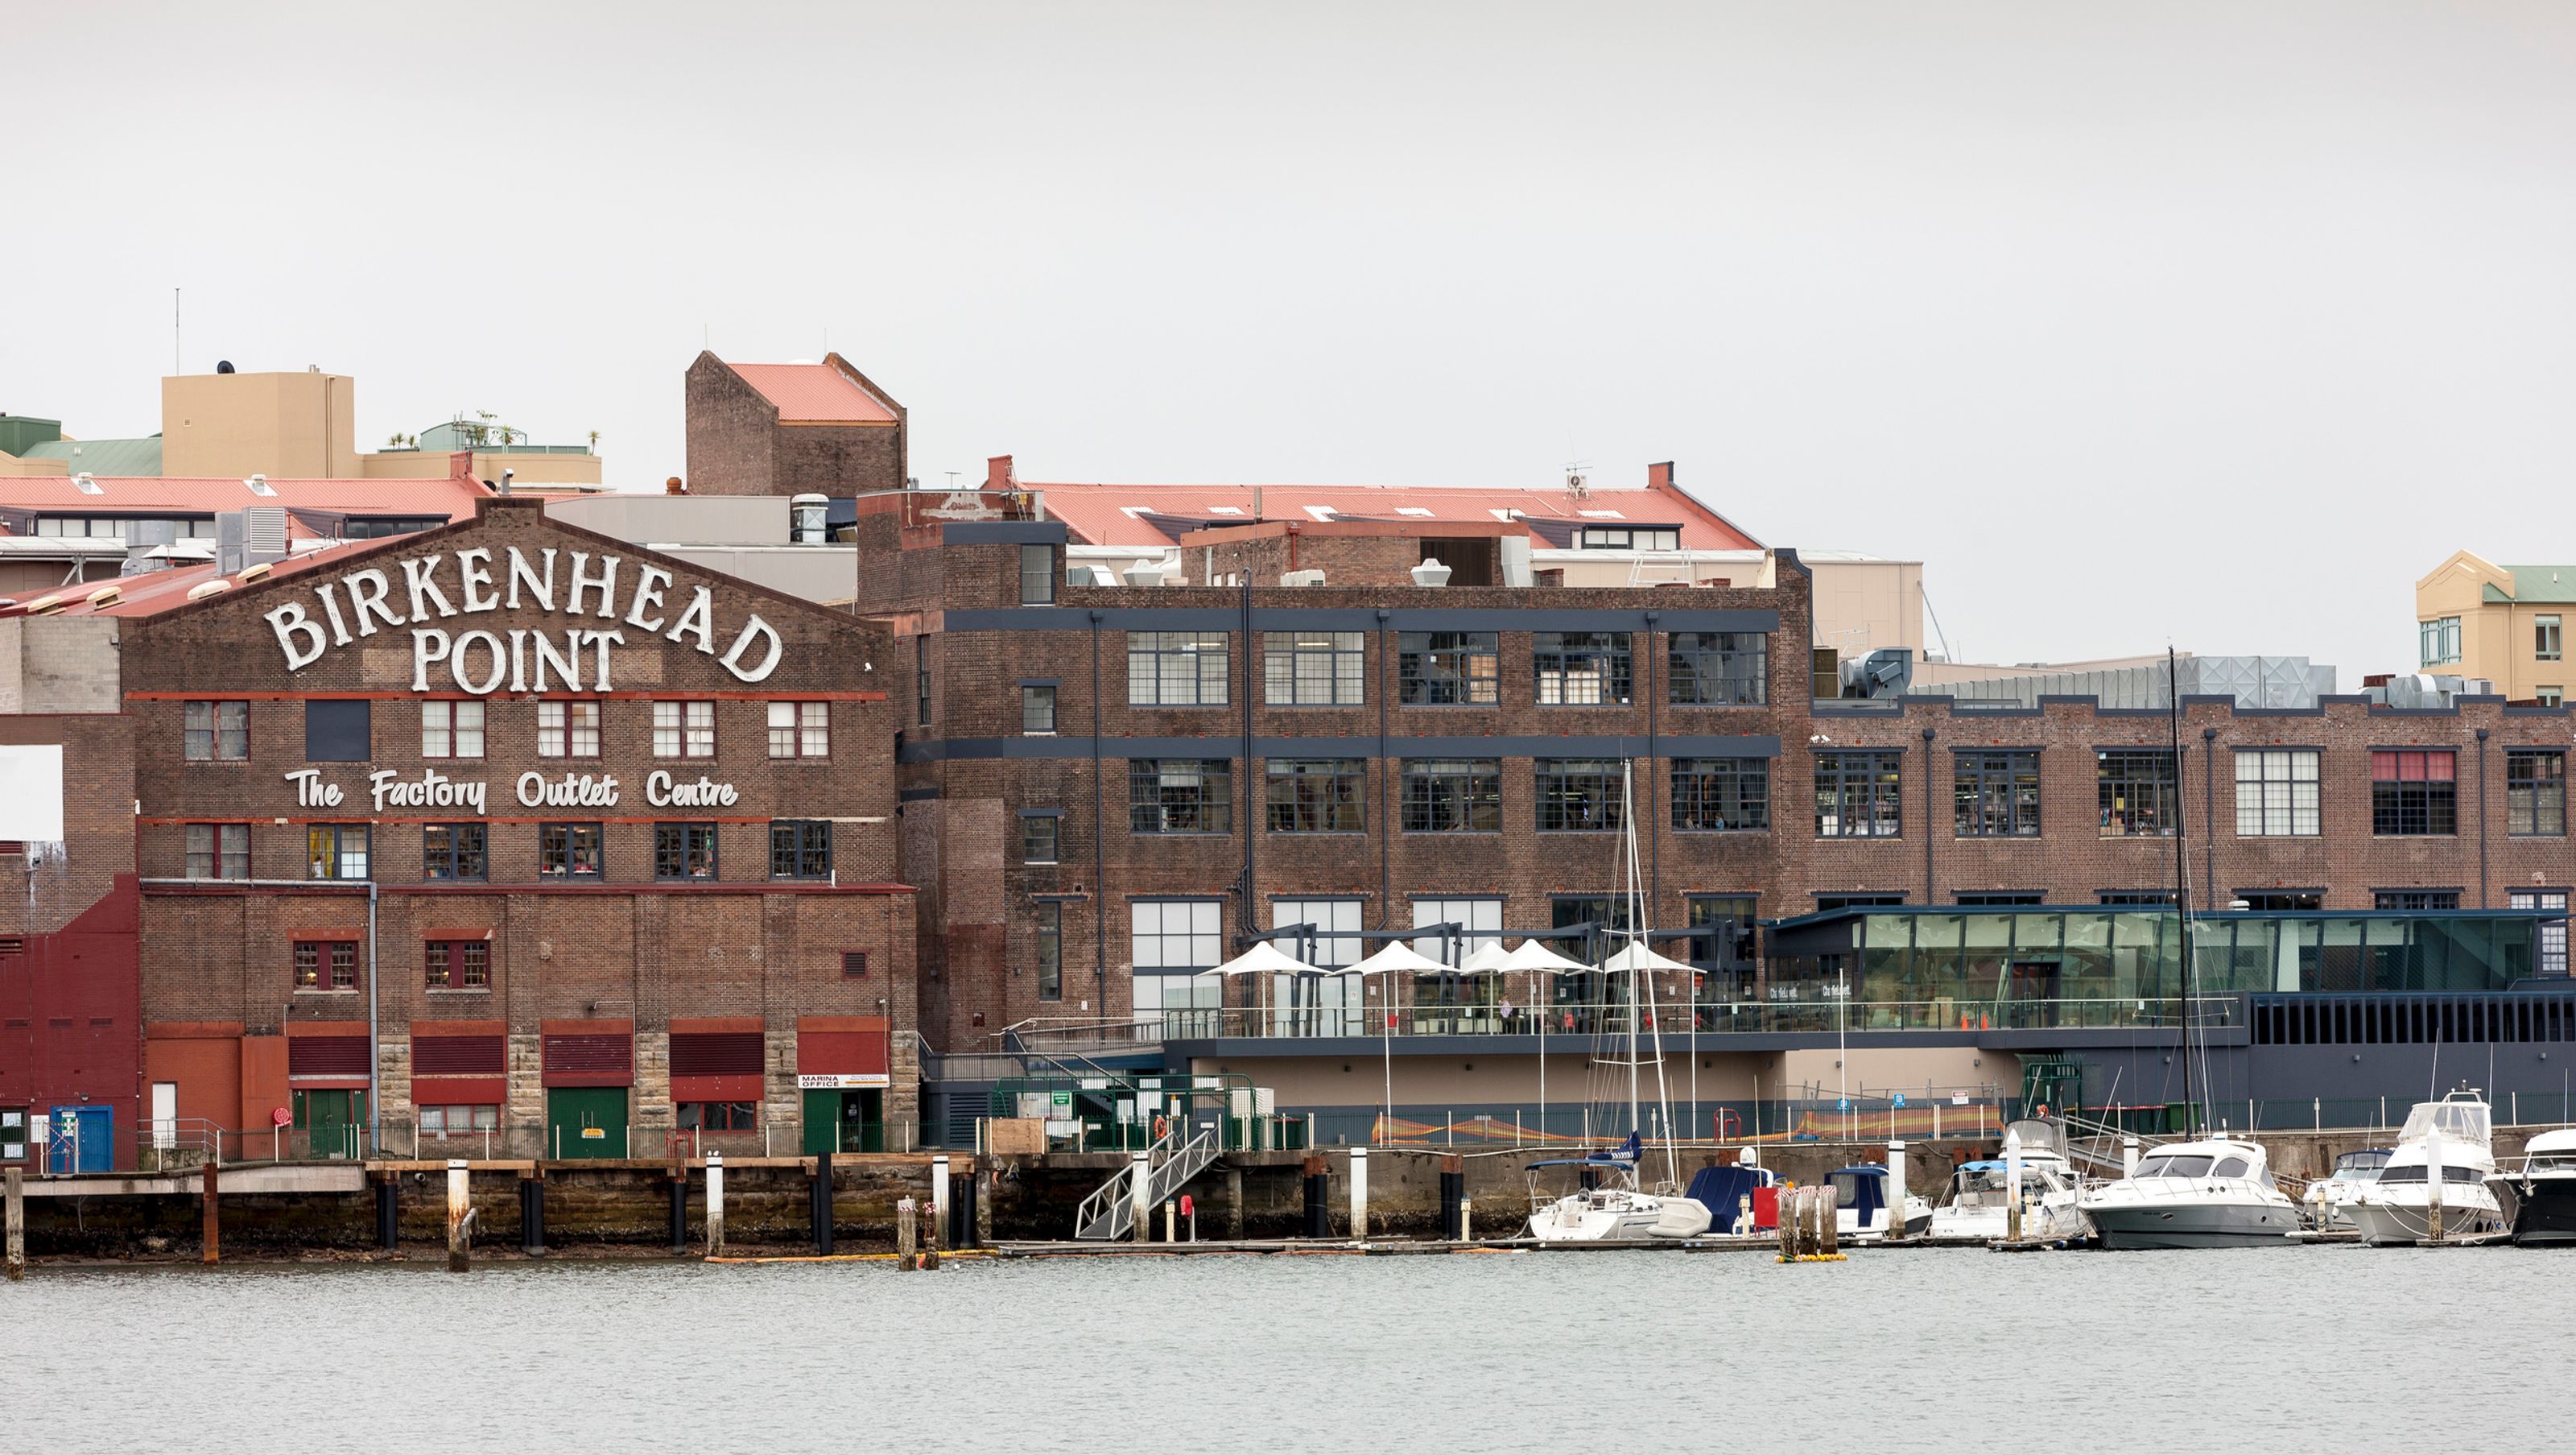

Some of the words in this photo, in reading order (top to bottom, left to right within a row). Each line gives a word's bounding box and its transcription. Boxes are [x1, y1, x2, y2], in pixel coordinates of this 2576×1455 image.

[263, 546, 782, 682] BIRKENHEAD
[411, 628, 625, 694] POINT
[284, 769, 345, 807] The
[369, 768, 487, 815] Factory
[516, 771, 619, 807] Outlet
[646, 770, 739, 807] Centre
